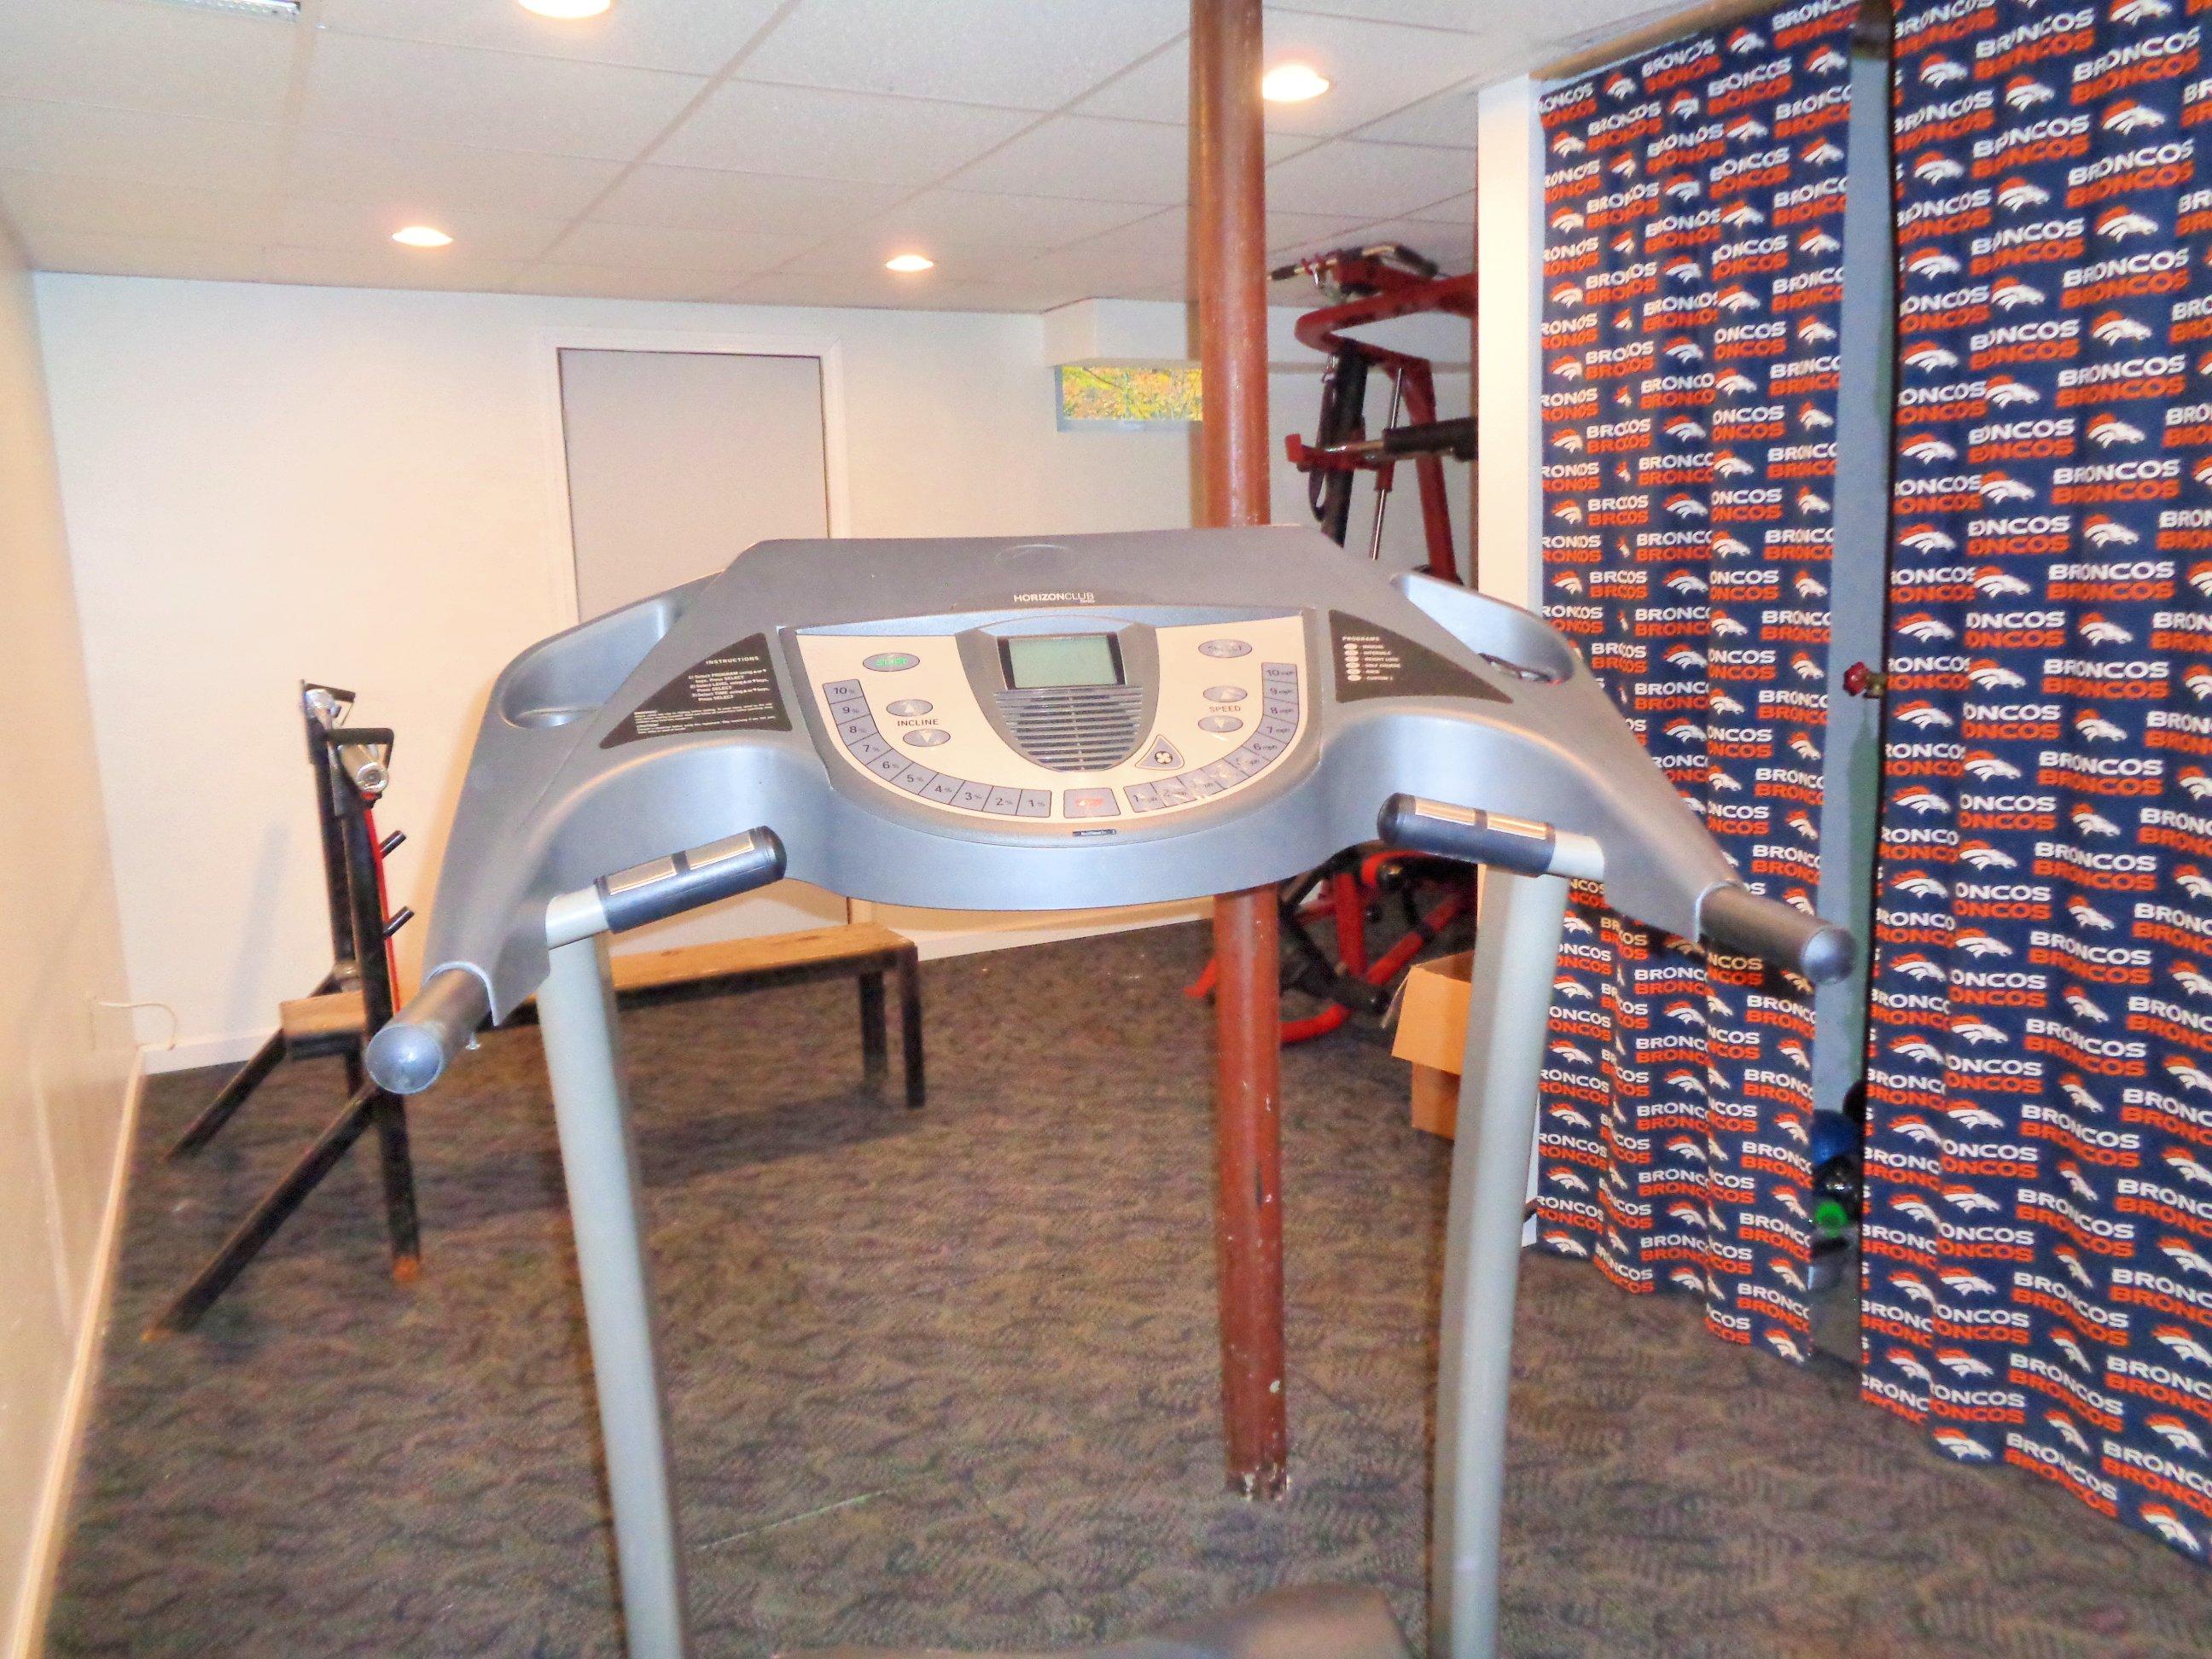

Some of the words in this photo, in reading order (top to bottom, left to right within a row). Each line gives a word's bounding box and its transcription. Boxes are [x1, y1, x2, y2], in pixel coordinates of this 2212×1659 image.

[2048, 561, 2174, 580] BRONCOS
[1013, 591, 1095, 602] HORIZONCLUB
[706, 655, 760, 665] INSTRUCTIONS
[2043, 659, 2169, 678] BRONCOS
[897, 719, 940, 727] INCLINE
[2039, 751, 2163, 776] BRONCOS
[2034, 841, 2157, 871] BRONCOS
[2030, 931, 2151, 965] BRONCOS
[2026, 1018, 2146, 1057] BRONCOS
[2022, 1104, 2140, 1149] BRONCOS
[2018, 1189, 2134, 1239] BRONCOS
[2014, 1272, 2129, 1328] BRONCOS
[2011, 1353, 2124, 1415] BRONCOS
[2007, 1433, 2118, 1500] BRONCOS
